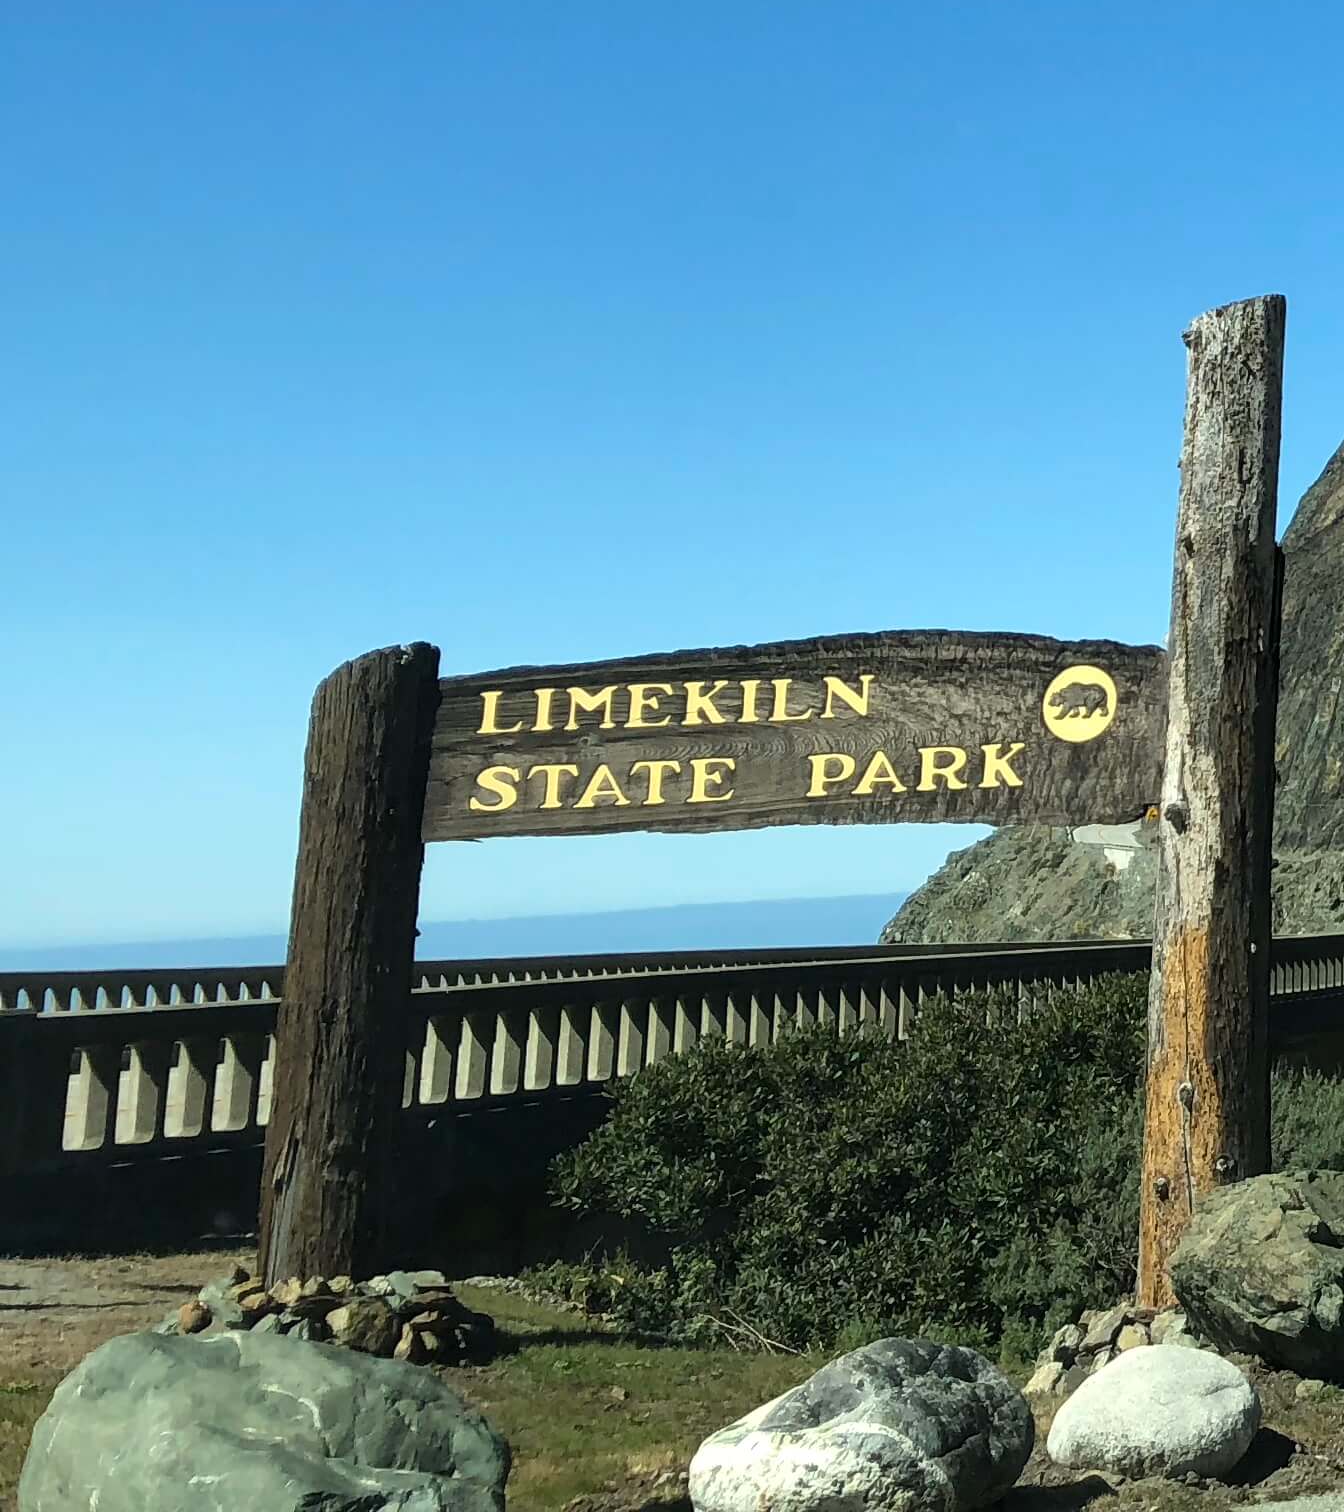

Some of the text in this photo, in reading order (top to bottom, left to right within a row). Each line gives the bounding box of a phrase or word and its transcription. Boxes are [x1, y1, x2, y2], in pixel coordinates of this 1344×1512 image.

[477, 673, 876, 735] LIMEKILN
[468, 741, 1027, 813] STATE PARK
